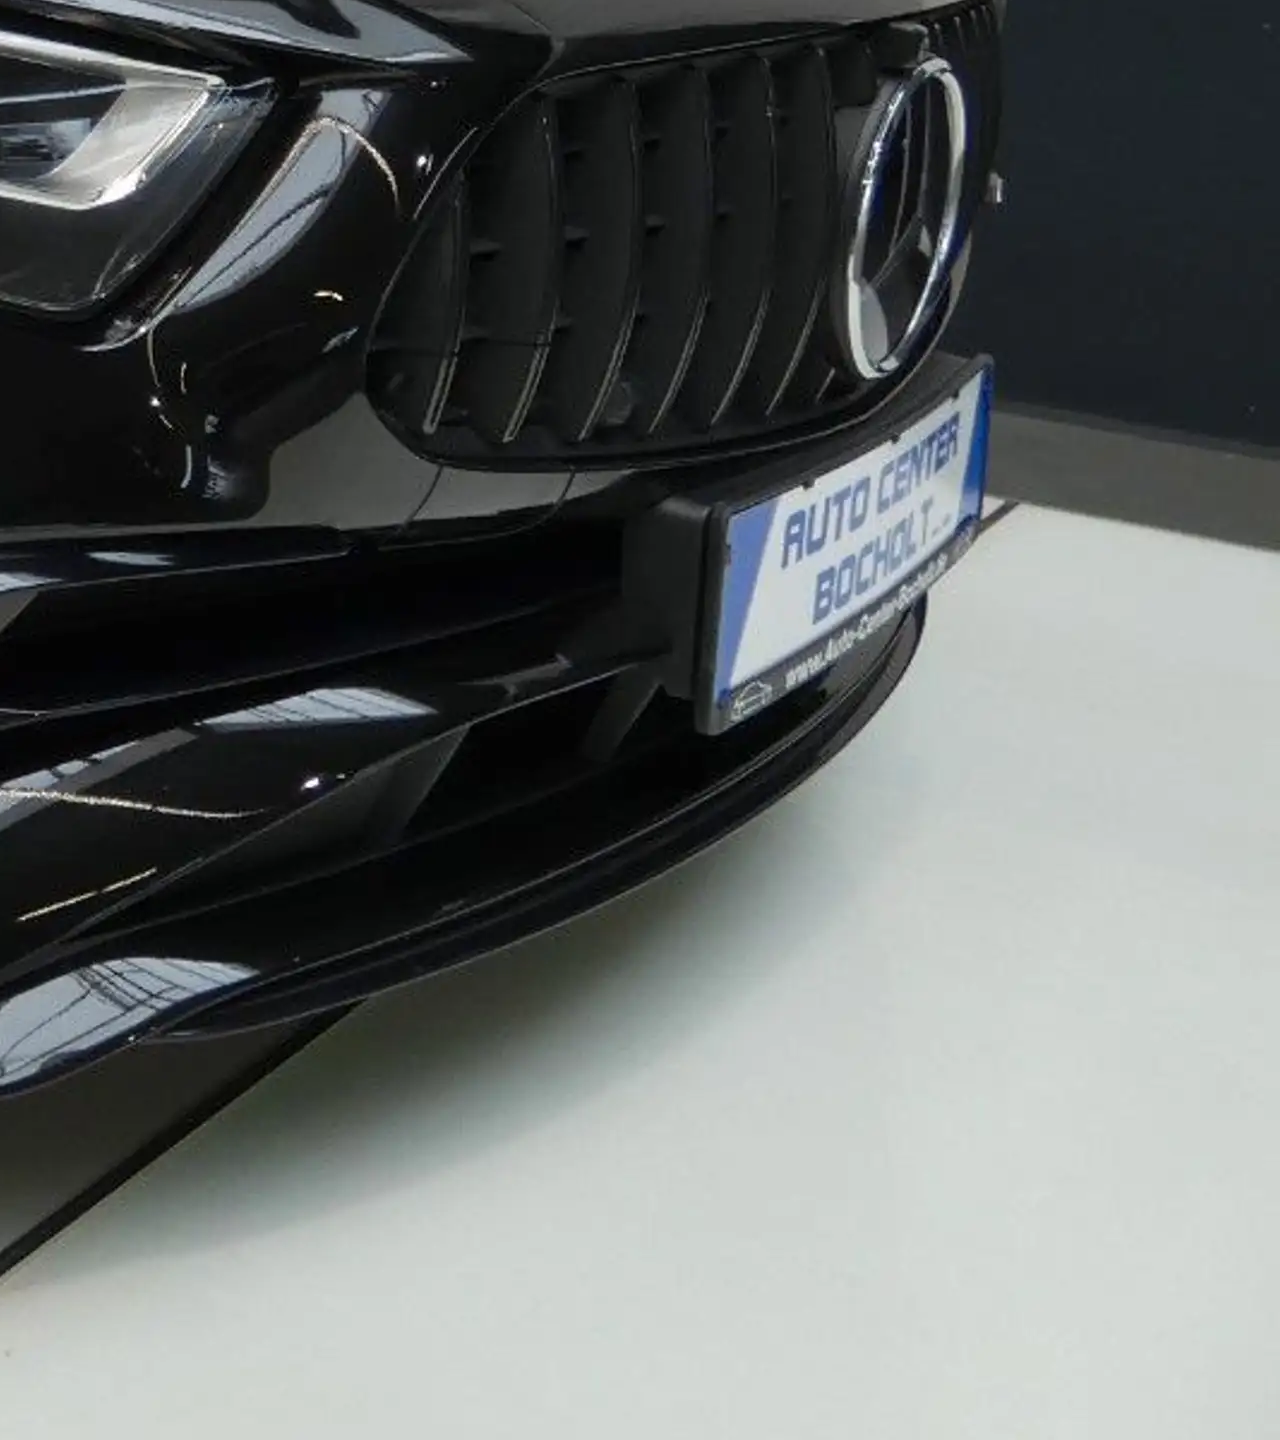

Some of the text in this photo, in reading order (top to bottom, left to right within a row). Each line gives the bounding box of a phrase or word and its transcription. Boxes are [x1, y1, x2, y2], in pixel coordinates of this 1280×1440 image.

[781, 412, 961, 569] AUTO CENTER
[813, 499, 933, 625] BOCHOLT
